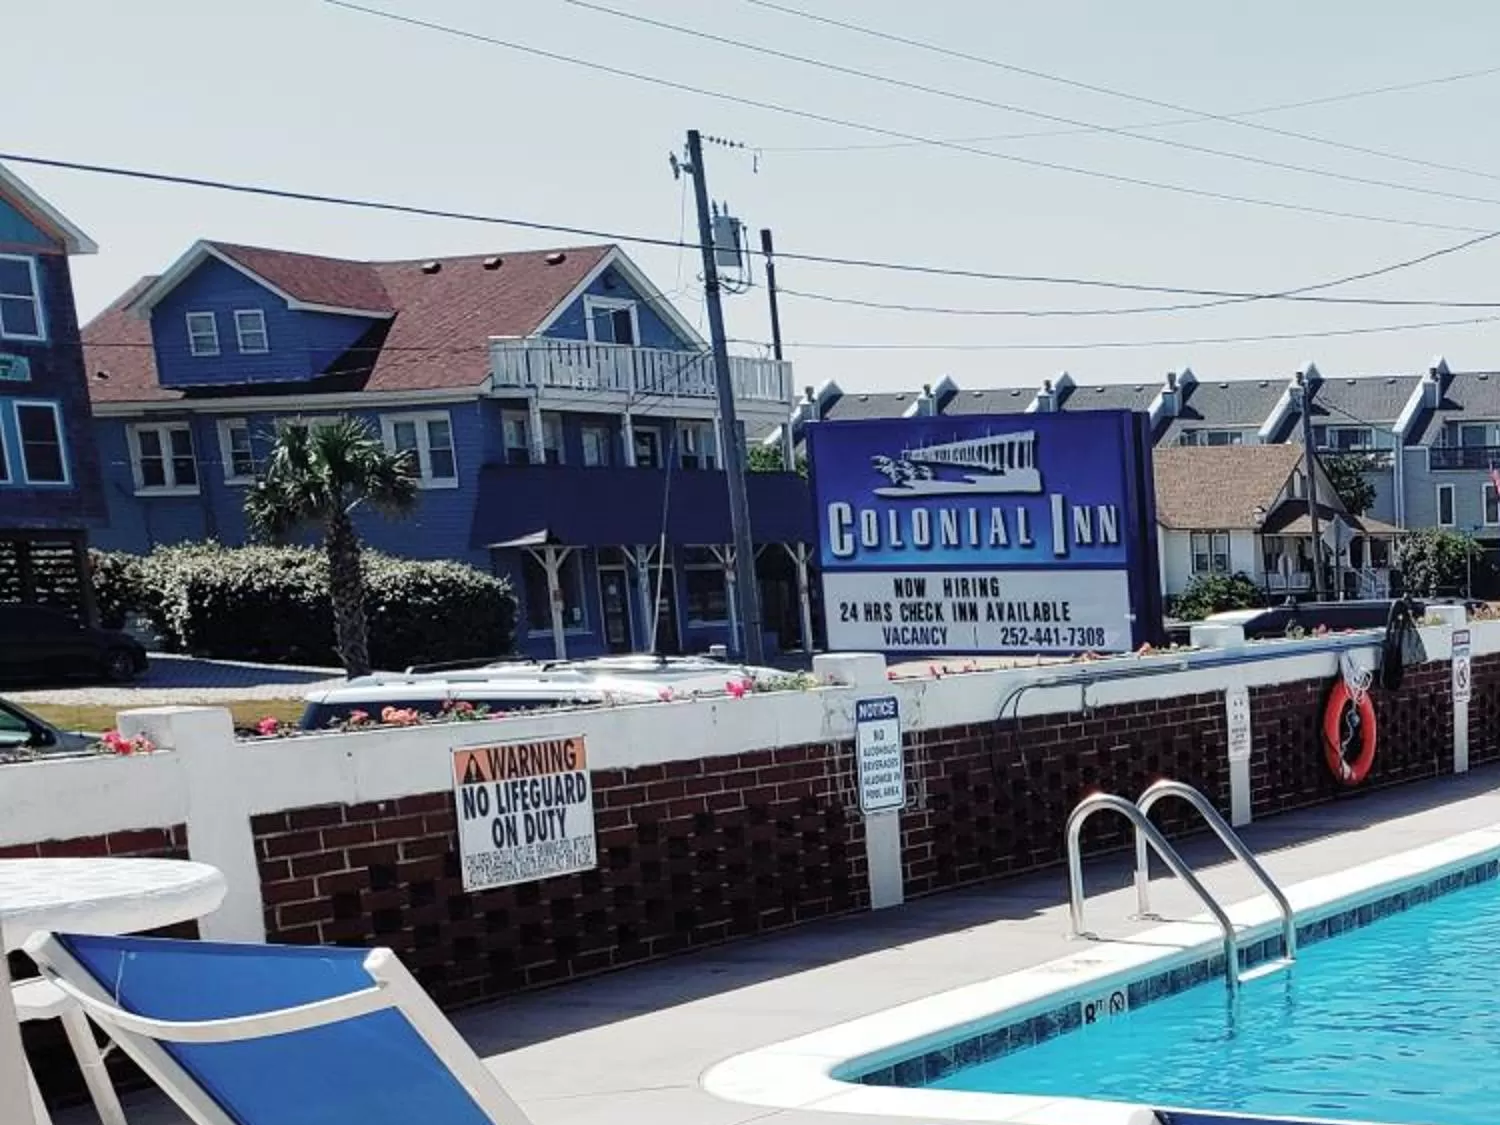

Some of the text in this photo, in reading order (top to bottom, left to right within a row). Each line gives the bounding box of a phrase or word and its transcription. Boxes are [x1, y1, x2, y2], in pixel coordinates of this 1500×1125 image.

[828, 493, 1120, 556] COLONIAL INN
[894, 577, 1000, 598] NOW HIRING
[840, 600, 1071, 622] 24 HRS CHECK INN AVAILABLE
[883, 626, 1105, 647] VACANCY 252-441-7308
[859, 701, 896, 718] NOTICE
[486, 739, 577, 780] WARNING
[462, 772, 587, 820] NO LIFEGUARD
[491, 807, 567, 849] ON DUTY
